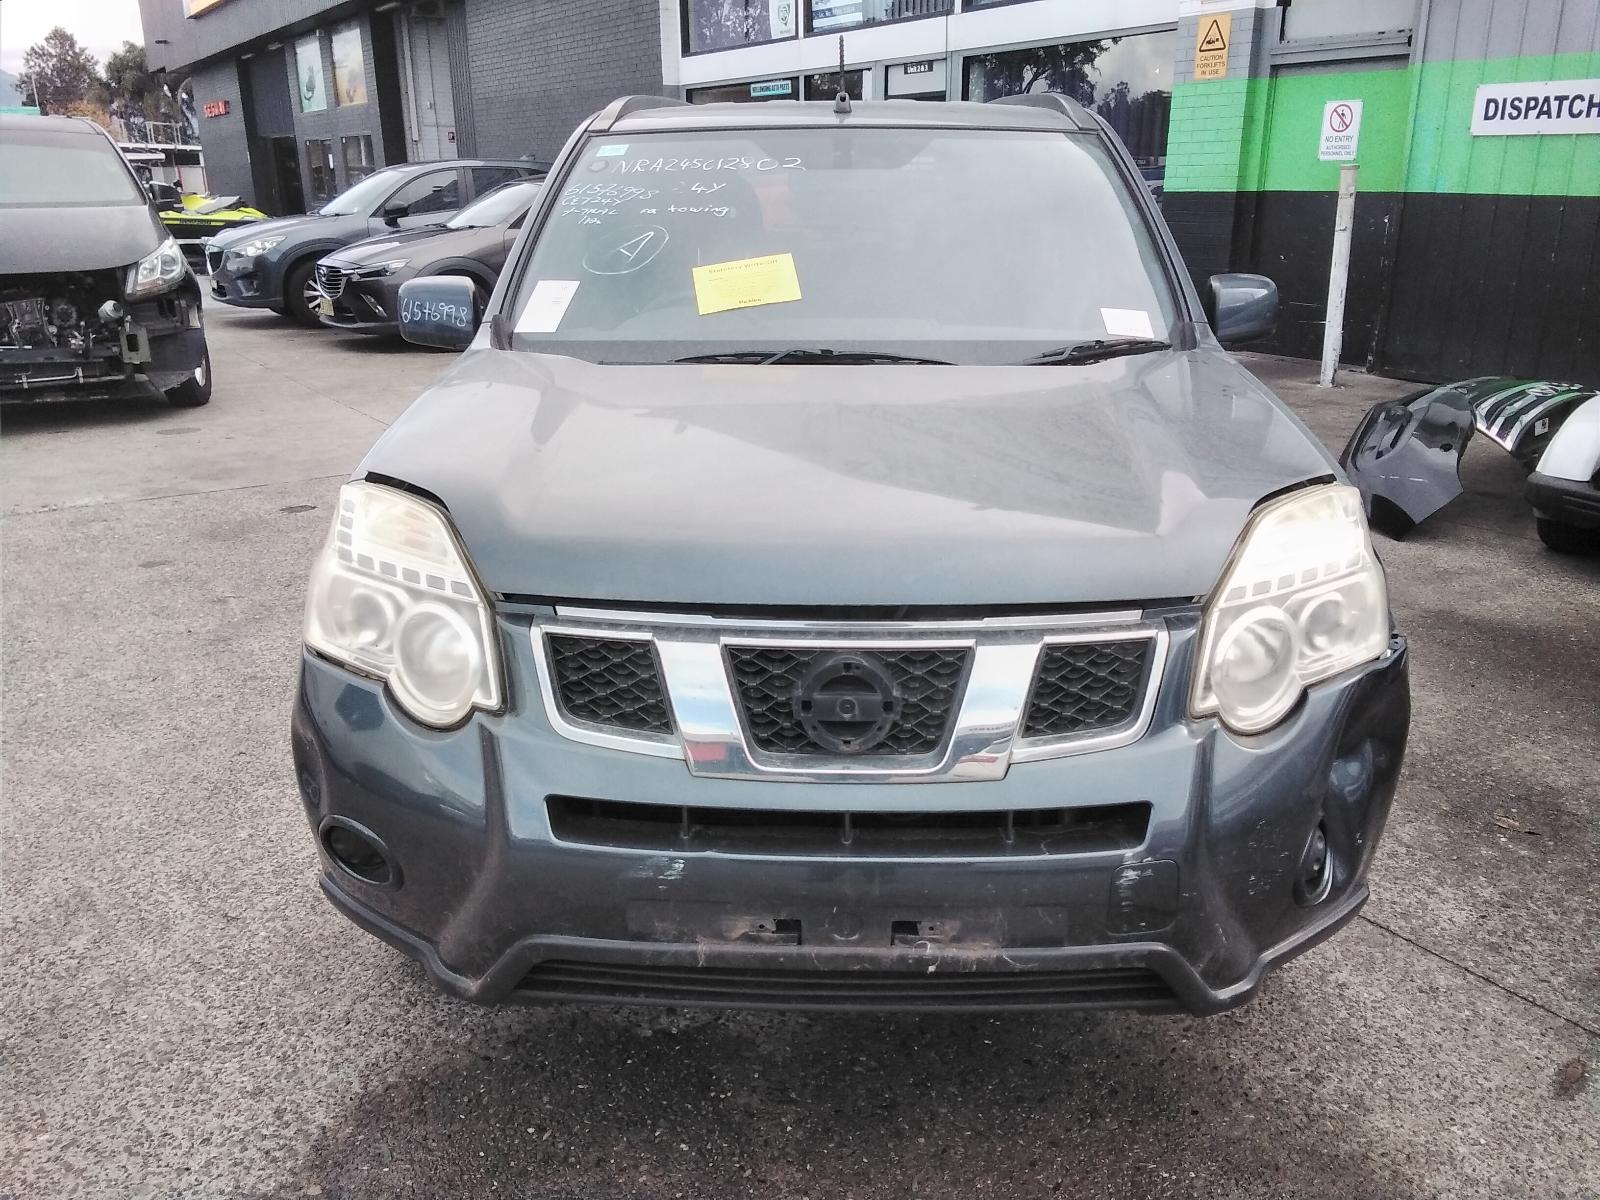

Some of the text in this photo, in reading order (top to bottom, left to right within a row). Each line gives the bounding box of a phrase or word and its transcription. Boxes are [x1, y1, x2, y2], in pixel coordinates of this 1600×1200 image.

[1197, 61, 1225, 69] FORKLIFTS
[1484, 94, 1600, 121] DISPATCH
[1335, 135, 1354, 143] ENTRY
[668, 204, 729, 217] towing
